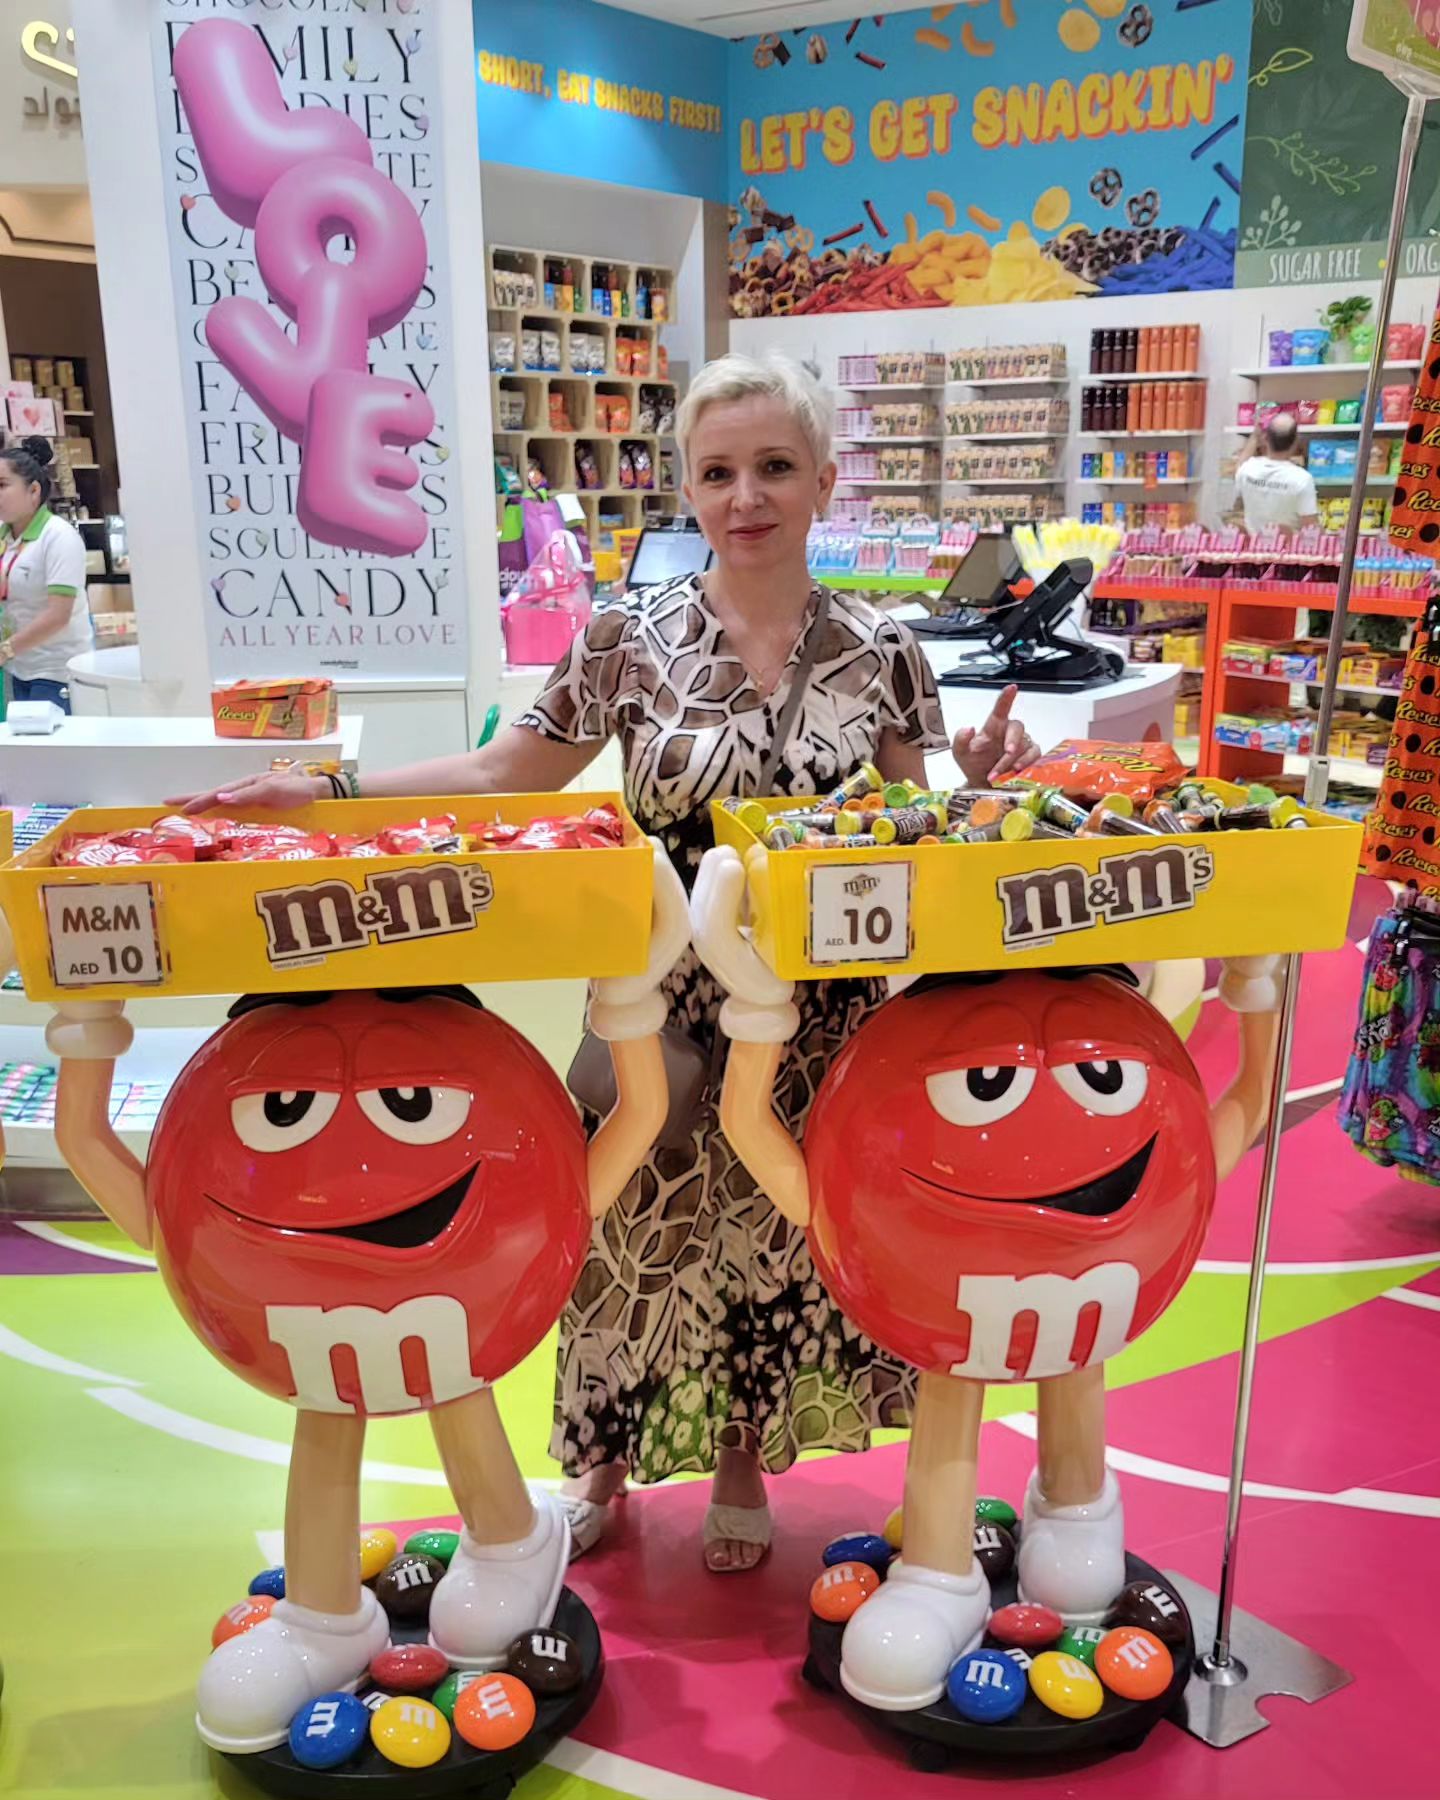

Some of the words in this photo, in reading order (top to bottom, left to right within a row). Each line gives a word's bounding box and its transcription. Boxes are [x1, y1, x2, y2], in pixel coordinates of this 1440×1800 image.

[557, 69, 591, 106] EAT
[594, 77, 664, 122] SNACKS
[669, 96, 722, 133] FIRST!
[739, 104, 855, 176] LET'S
[869, 92, 959, 162] GET
[972, 52, 1236, 151] SNACKIN'
[1268, 252, 1322, 284] SUGAR
[1327, 247, 1362, 279] FREE
[212, 568, 451, 619] CANDY
[219, 624, 276, 648] ALL
[285, 624, 365, 647] YEAR
[376, 623, 457, 646] LOVE
[62, 904, 141, 933] M&M
[824, 938, 845, 946] AED
[844, 906, 893, 946] 10
[69, 963, 100, 976] AED
[102, 945, 144, 975] 10
